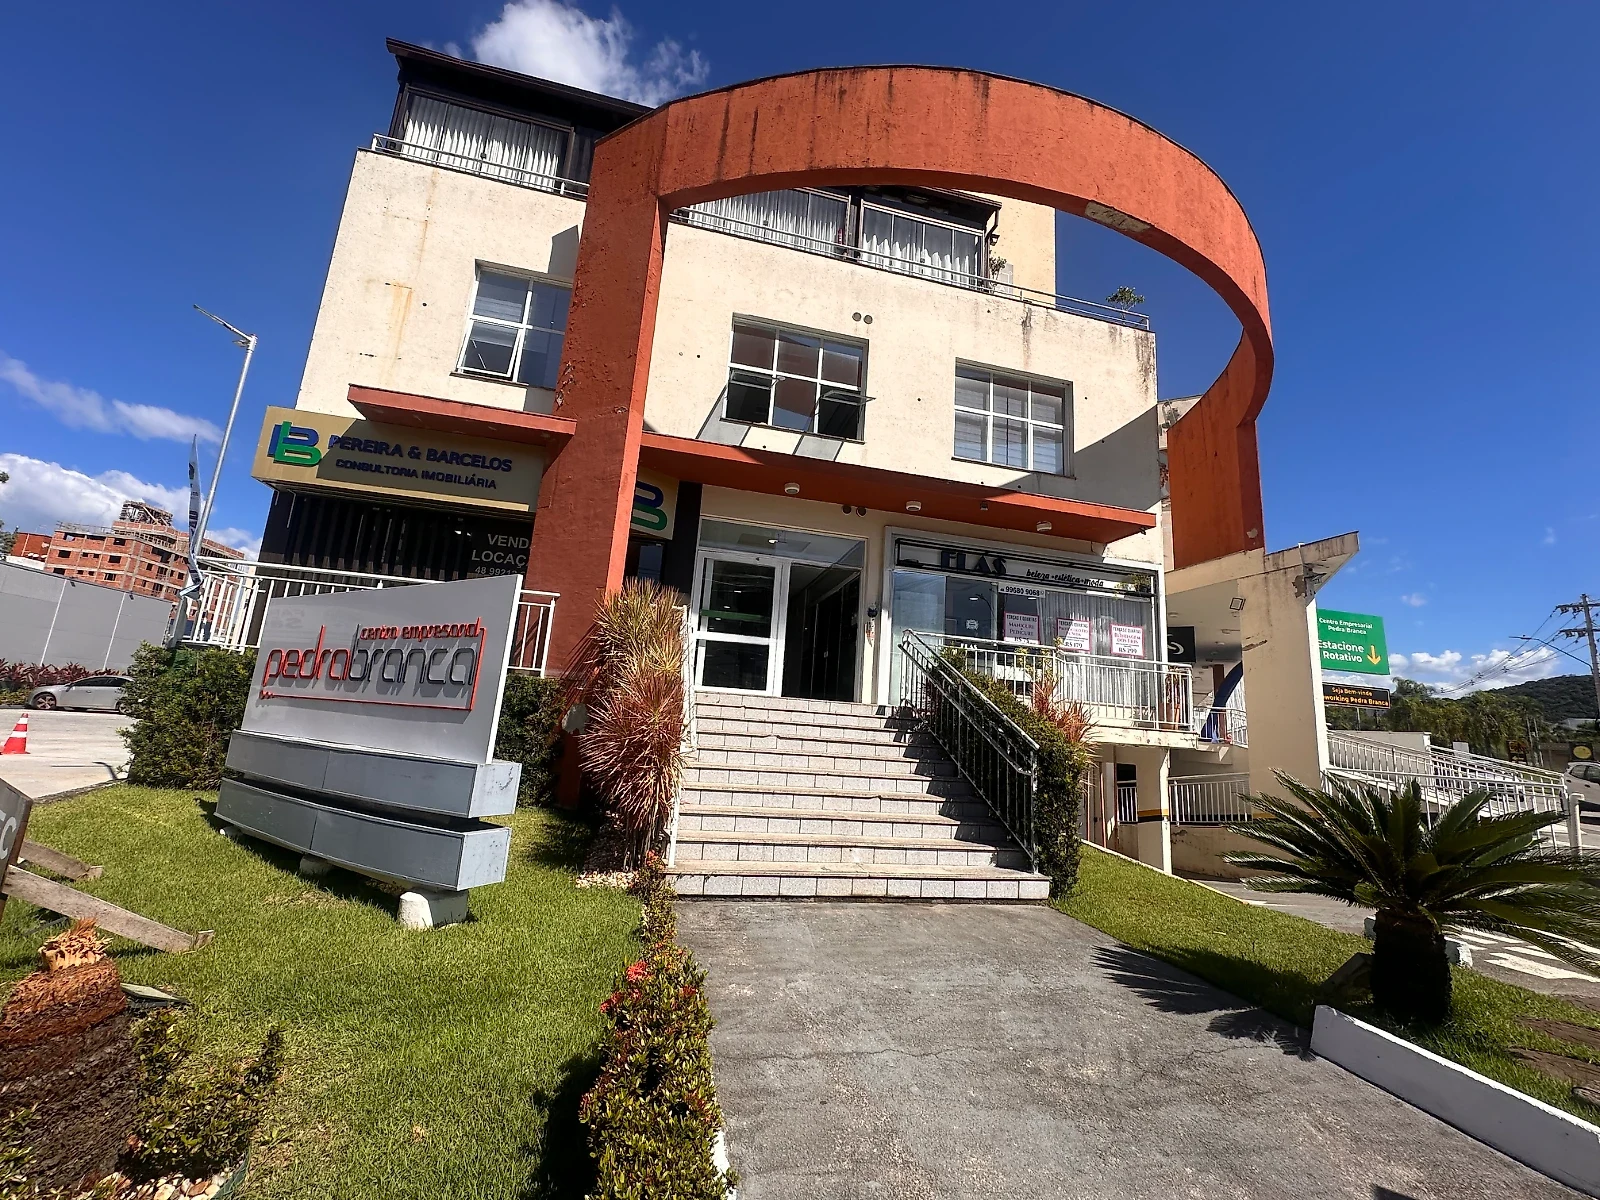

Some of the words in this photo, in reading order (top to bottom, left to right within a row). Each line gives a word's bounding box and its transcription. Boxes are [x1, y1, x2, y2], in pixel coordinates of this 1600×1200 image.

[328, 434, 403, 458] PEREIRA
[408, 445, 421, 460] &
[426, 448, 513, 473] BARCELOS
[335, 458, 419, 479] CONSULTORIA
[421, 469, 497, 489] IMOBILIÁRIA
[487, 533, 531, 549] VEND
[471, 549, 528, 569] LOCAÇ
[475, 566, 487, 575] 48
[1318, 617, 1339, 625] Centro
[1339, 620, 1373, 629] Empresarial
[1327, 625, 1346, 633] Pedra
[1322, 650, 1363, 663] Rotativo
[1323, 695, 1350, 703] working
[1350, 696, 1368, 704] Pedra
[1368, 698, 1390, 706] Branca
